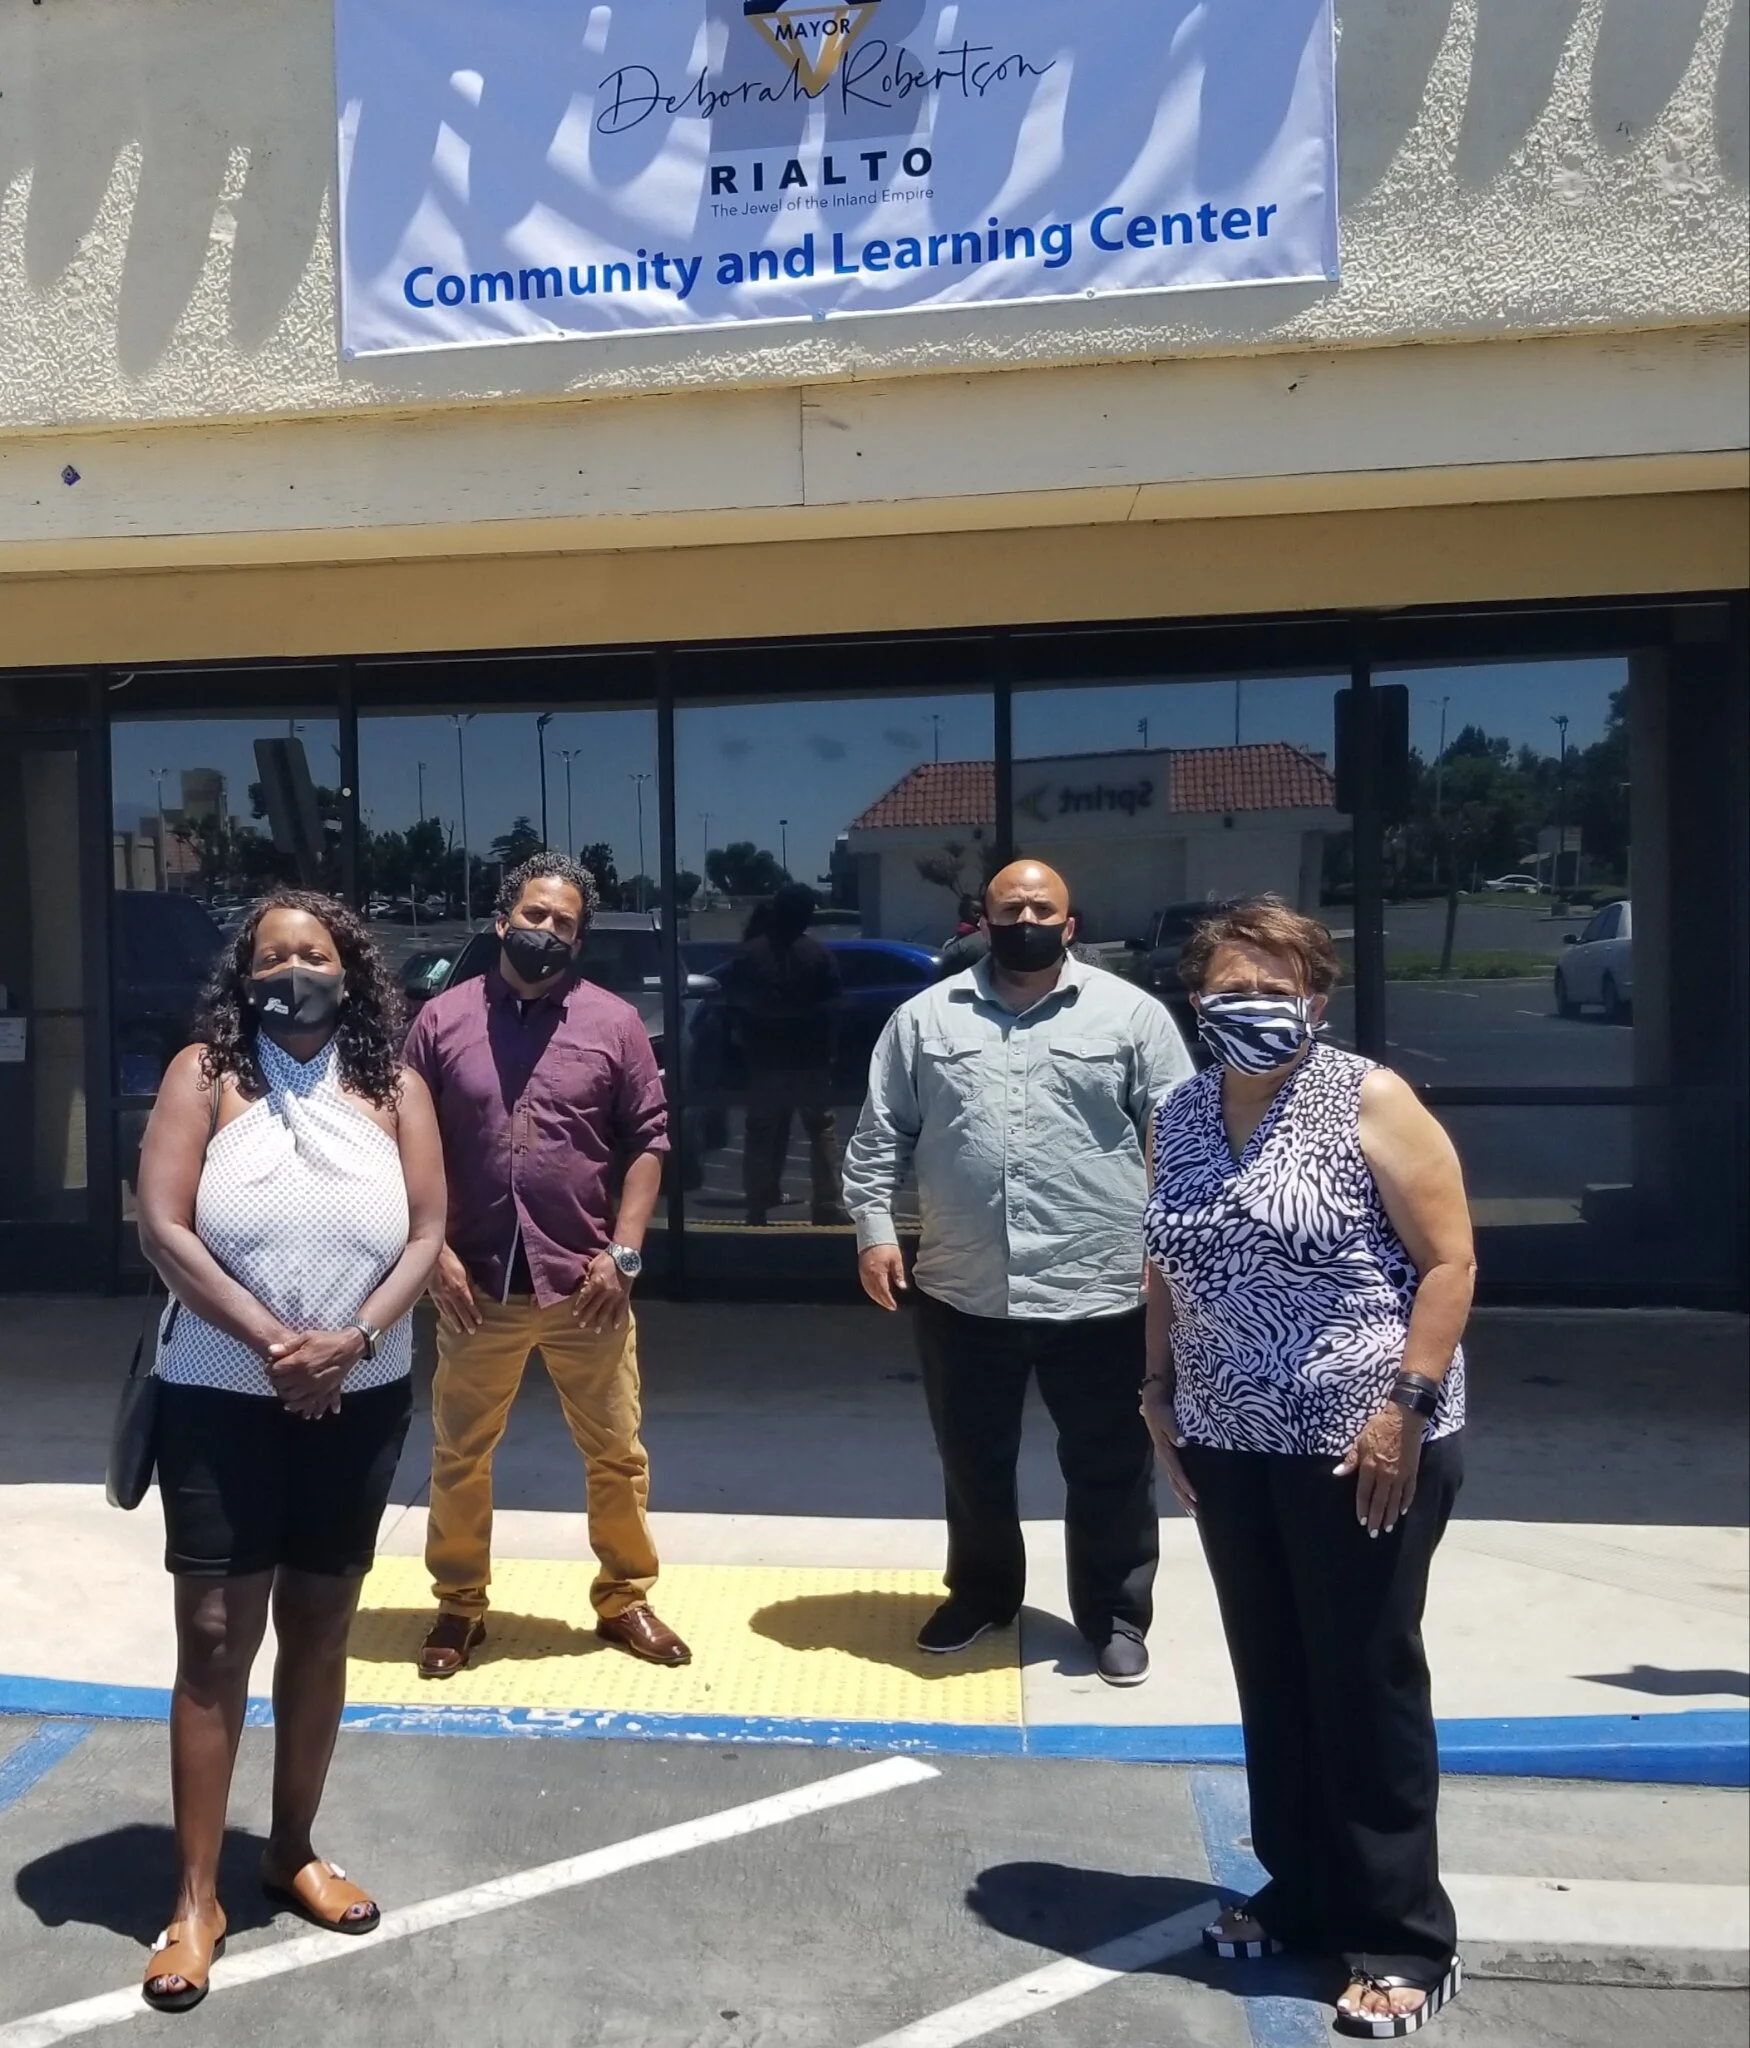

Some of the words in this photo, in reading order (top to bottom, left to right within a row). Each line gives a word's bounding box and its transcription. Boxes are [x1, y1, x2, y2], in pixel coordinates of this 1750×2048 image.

[775, 18, 850, 41] MAYOR
[597, 58, 830, 133] Deborah
[842, 40, 1056, 115] Robertson
[711, 147, 932, 195] RIALTO
[712, 204, 737, 218] The
[742, 199, 782, 215] Jewel
[787, 196, 802, 211] of
[805, 193, 828, 209] the
[833, 189, 877, 207] Inland
[882, 187, 934, 203] Empire
[403, 249, 702, 308] Community
[717, 233, 814, 284] and
[833, 217, 1072, 274] Learning
[1090, 201, 1277, 251] Center
